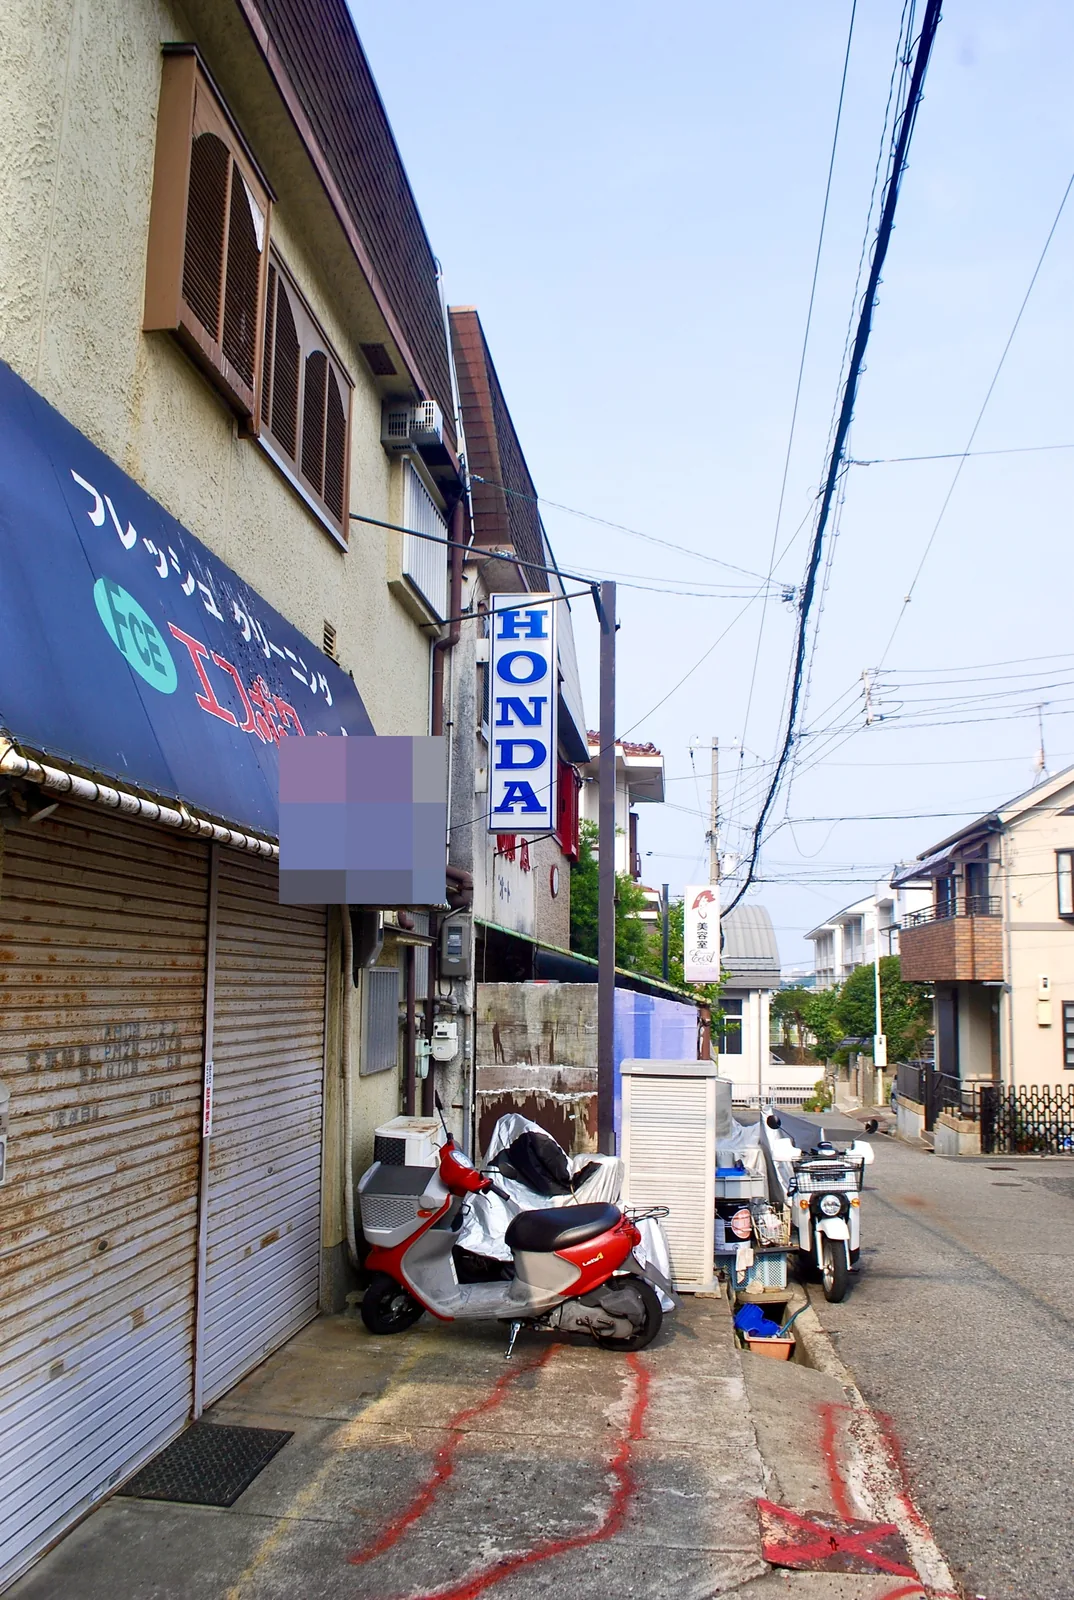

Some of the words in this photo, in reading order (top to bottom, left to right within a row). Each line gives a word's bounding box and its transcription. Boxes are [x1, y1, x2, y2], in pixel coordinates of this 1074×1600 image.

[102, 577, 167, 677] FCE
[493, 609, 549, 814] HONDA
[696, 922, 708, 949] 美容室
